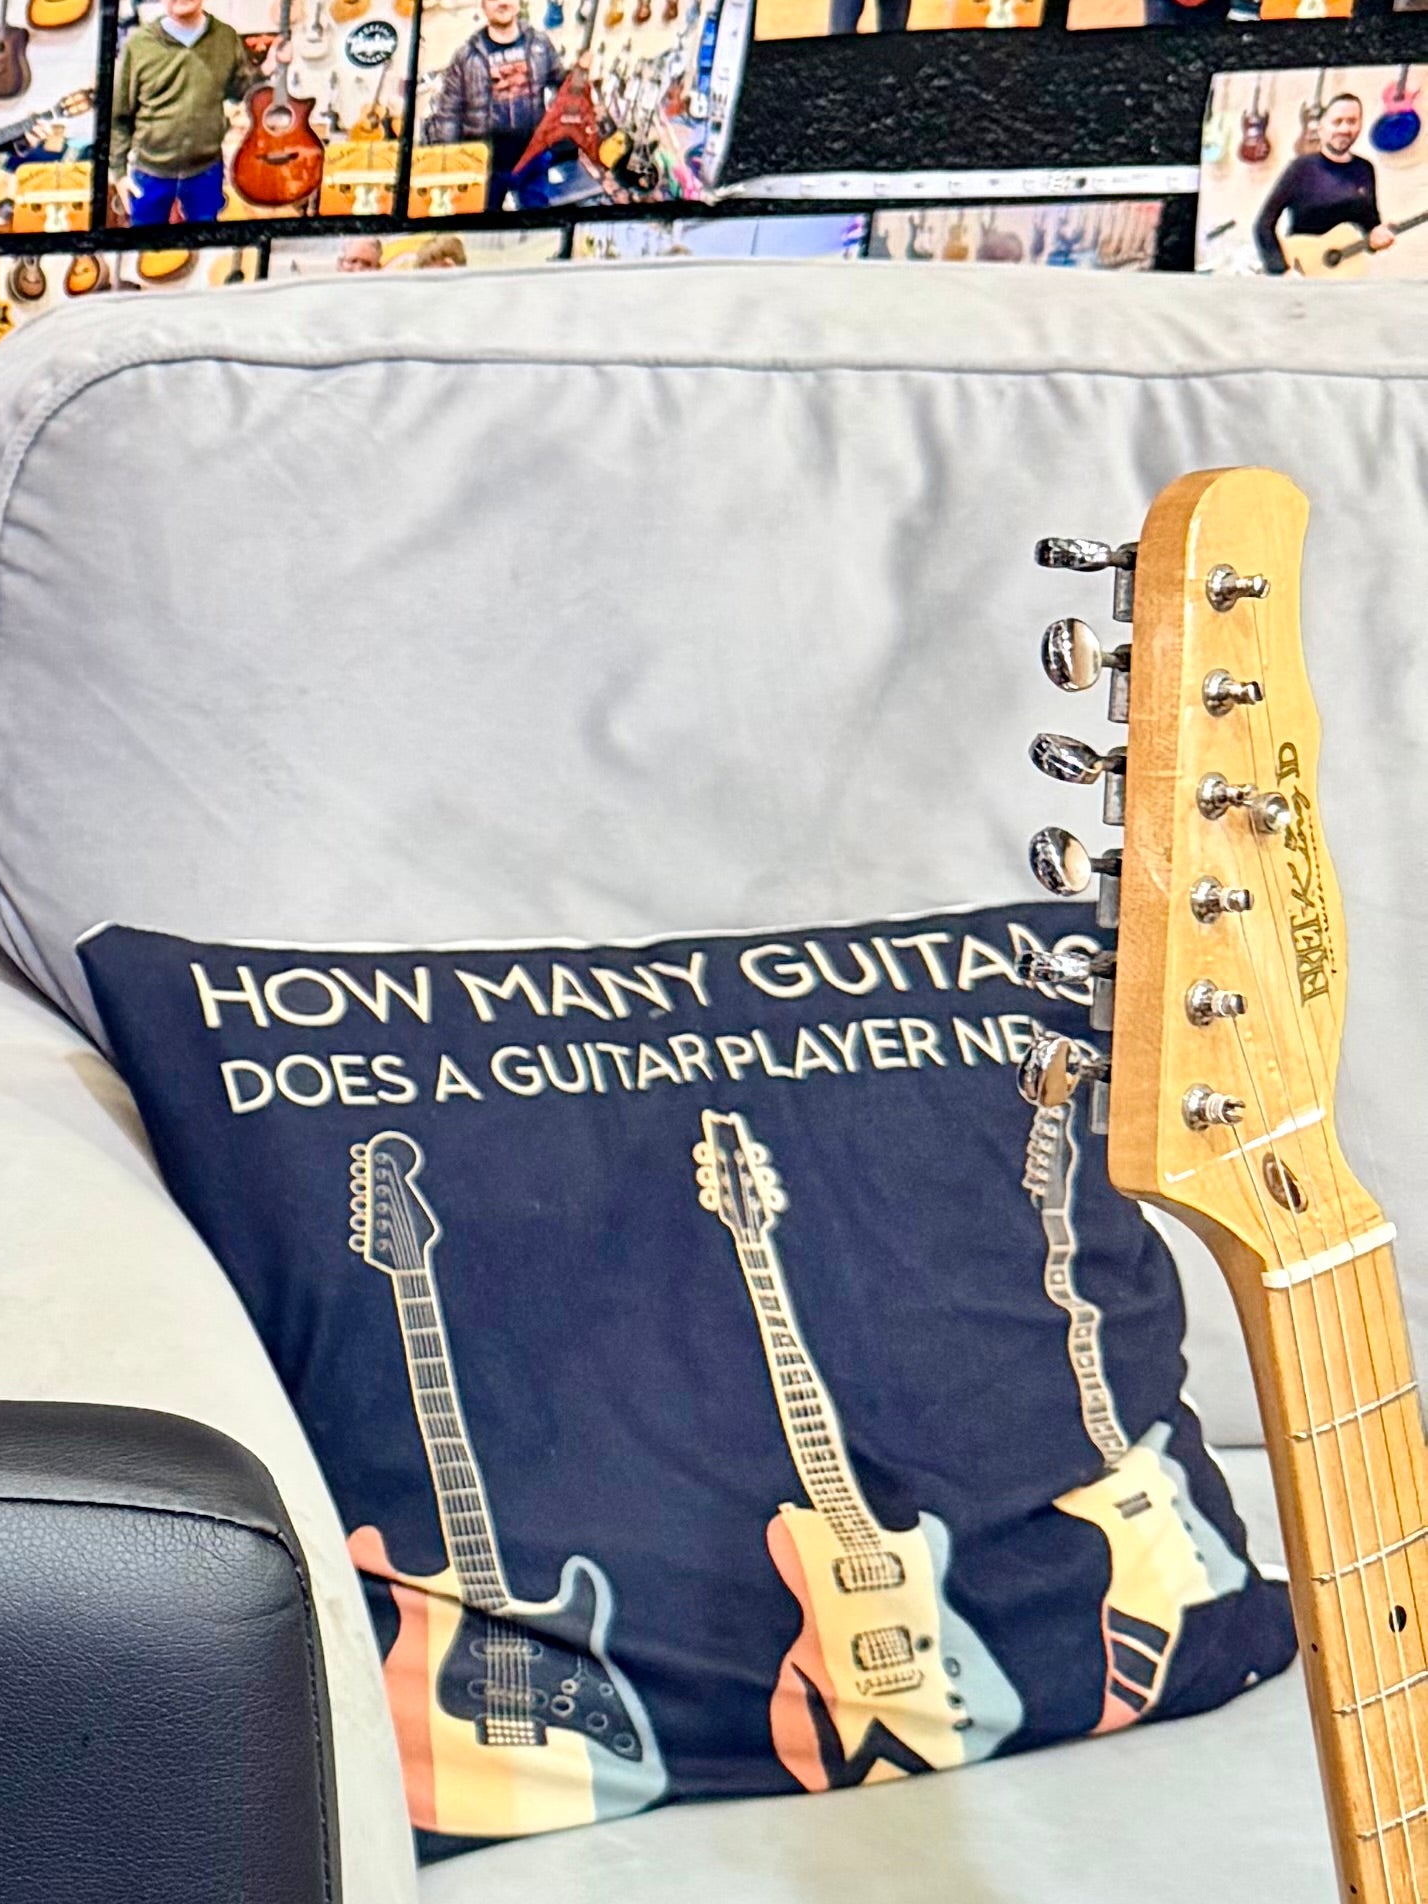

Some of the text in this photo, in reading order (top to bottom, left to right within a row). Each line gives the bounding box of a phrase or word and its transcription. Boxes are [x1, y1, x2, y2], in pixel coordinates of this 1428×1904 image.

[189, 962, 432, 1029] HOW
[454, 951, 712, 1023] MANY
[220, 1053, 419, 1114] DOES
[434, 1053, 486, 1103] A
[490, 1032, 715, 1094] GUITAR
[715, 1015, 948, 1082] PLAYER
